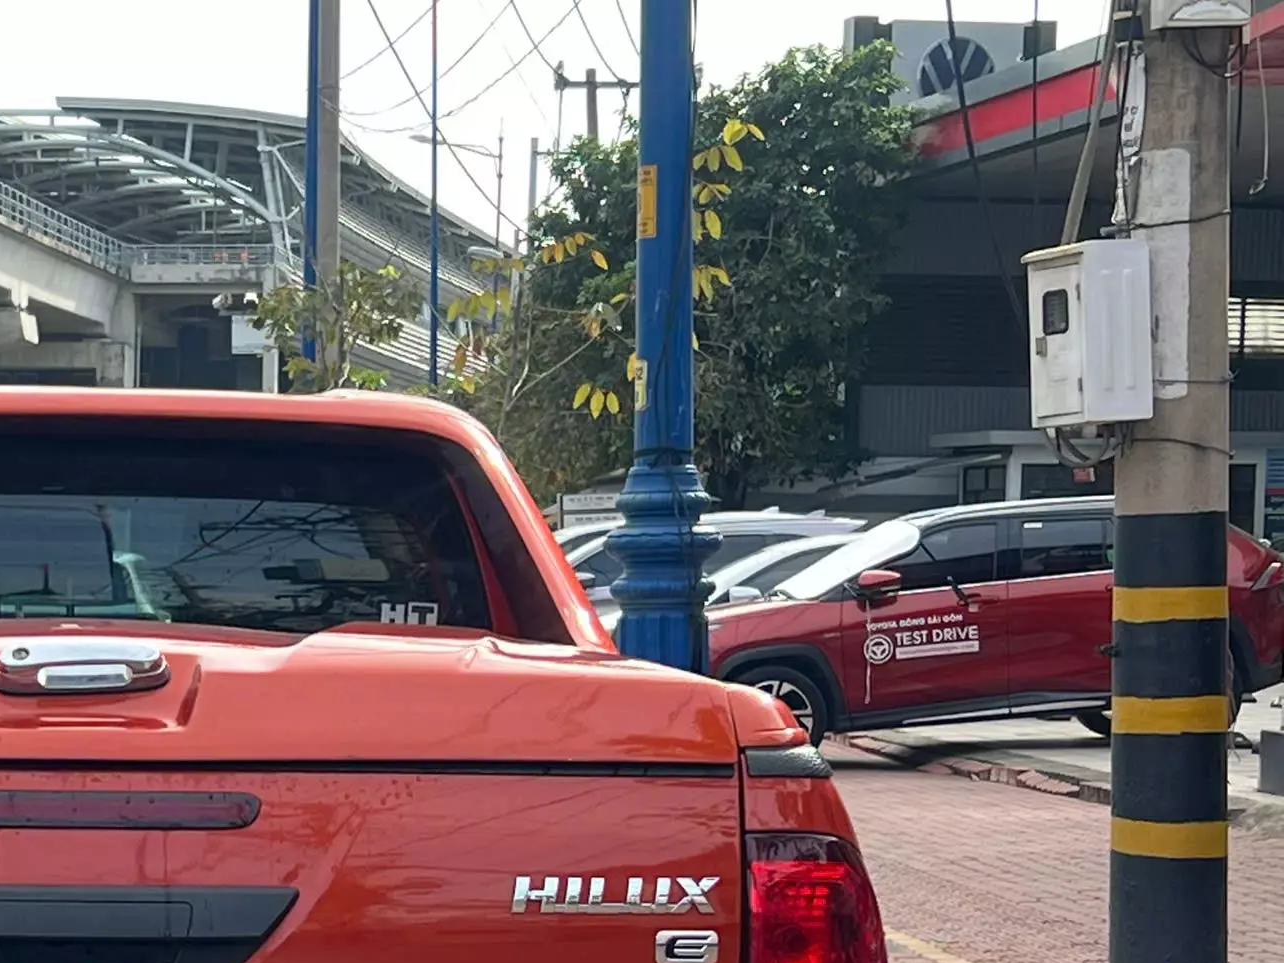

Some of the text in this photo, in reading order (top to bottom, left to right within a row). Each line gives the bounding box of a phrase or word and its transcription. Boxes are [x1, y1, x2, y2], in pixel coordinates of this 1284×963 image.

[895, 625, 979, 646] TEST DRIVE
[511, 876, 720, 914] HILUX
